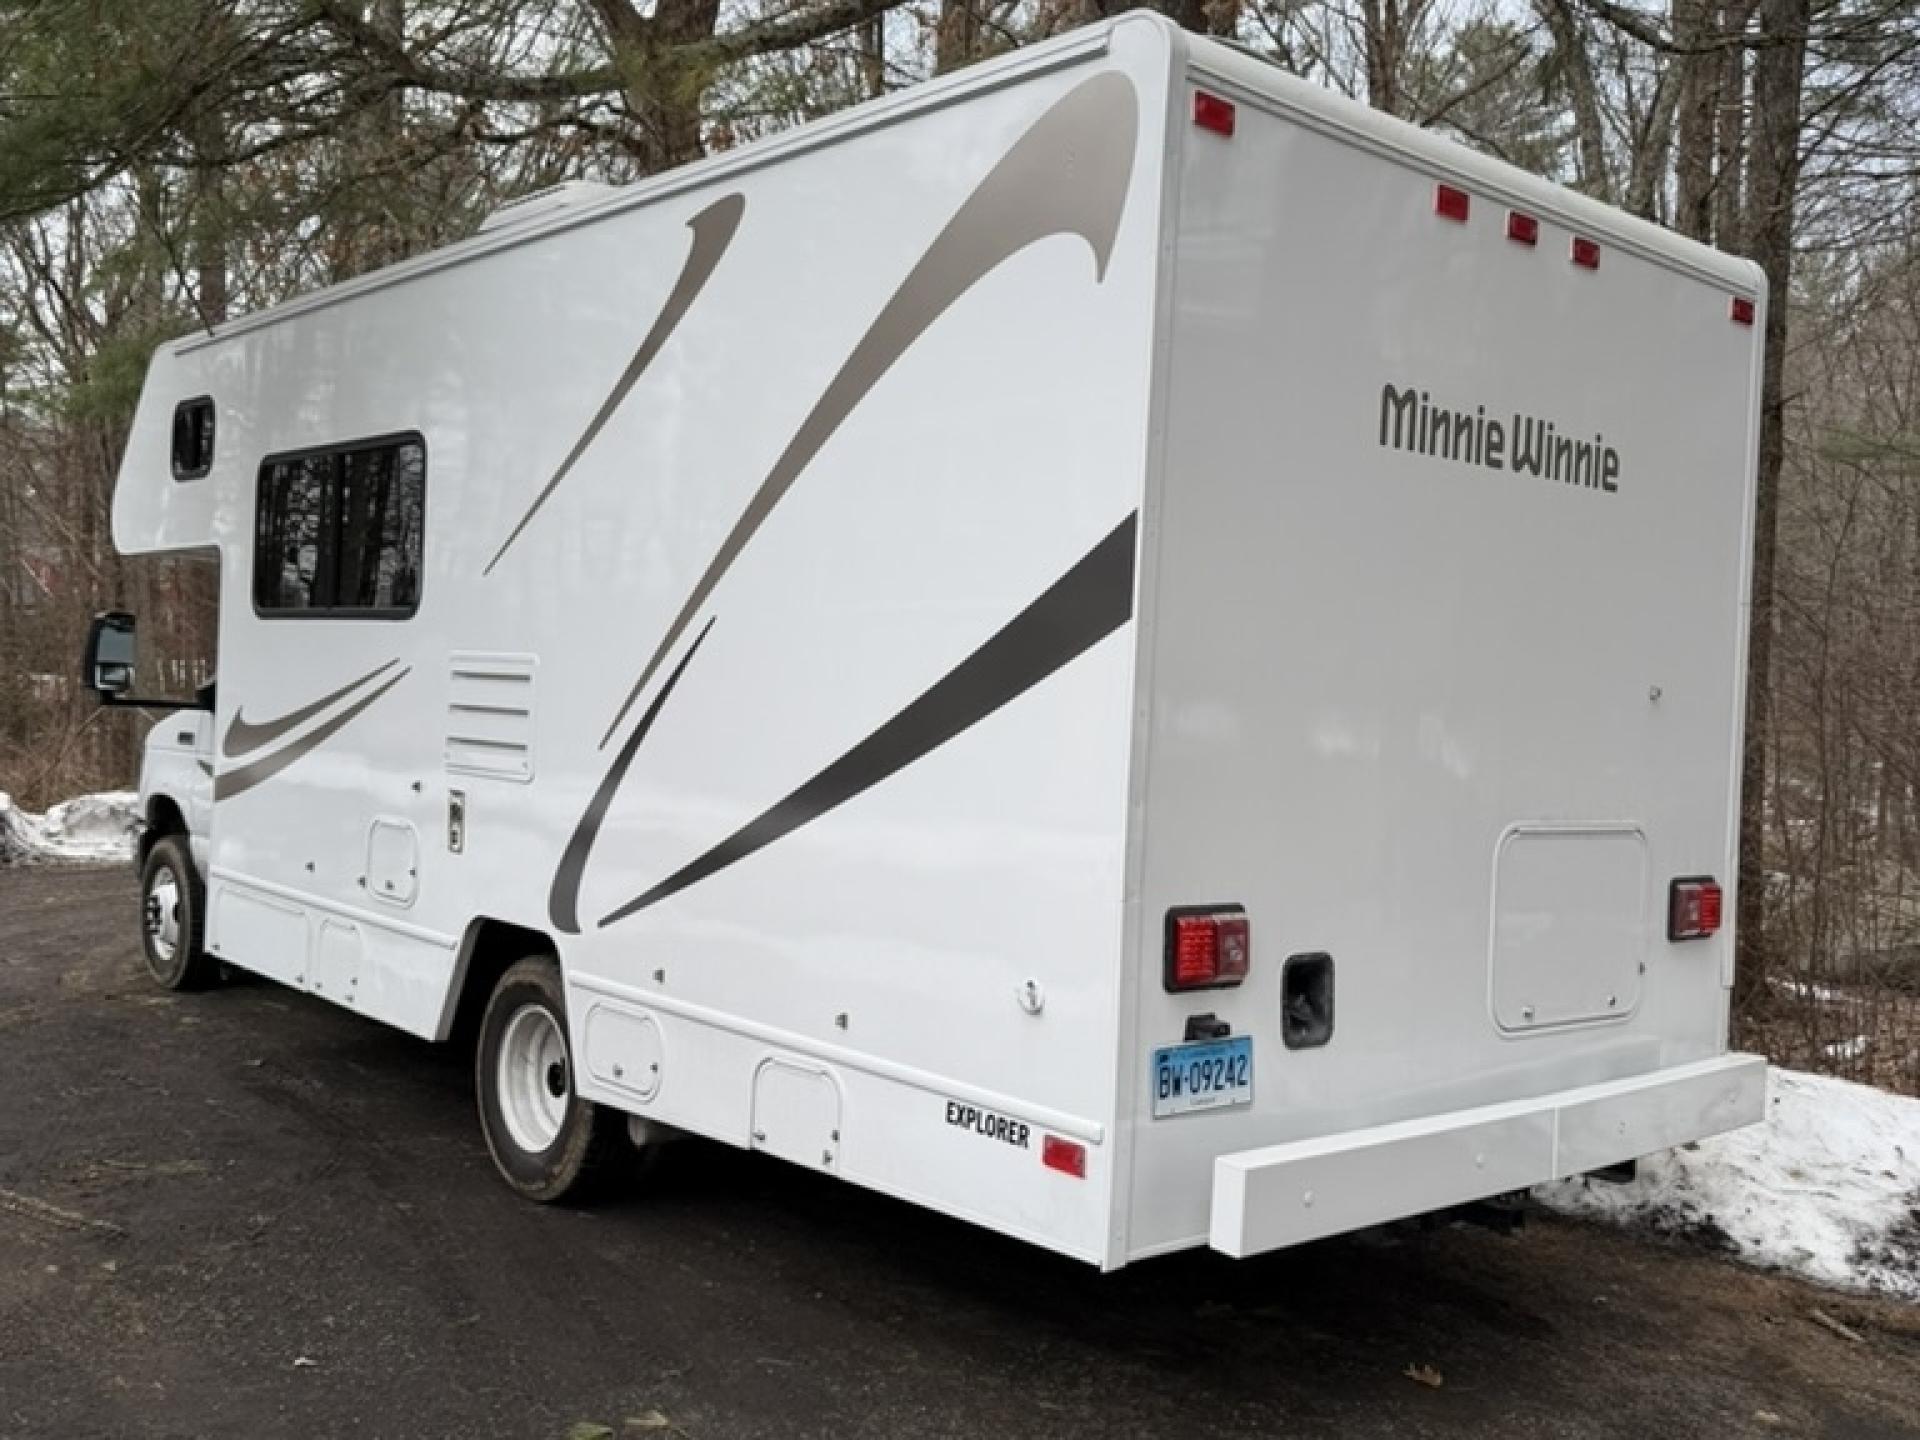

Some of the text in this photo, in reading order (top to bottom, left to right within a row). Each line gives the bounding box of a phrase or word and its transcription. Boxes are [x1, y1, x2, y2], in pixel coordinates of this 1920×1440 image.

[1380, 383, 1620, 492] Minnie Winnie
[946, 1101, 1030, 1149] EXPLORER
